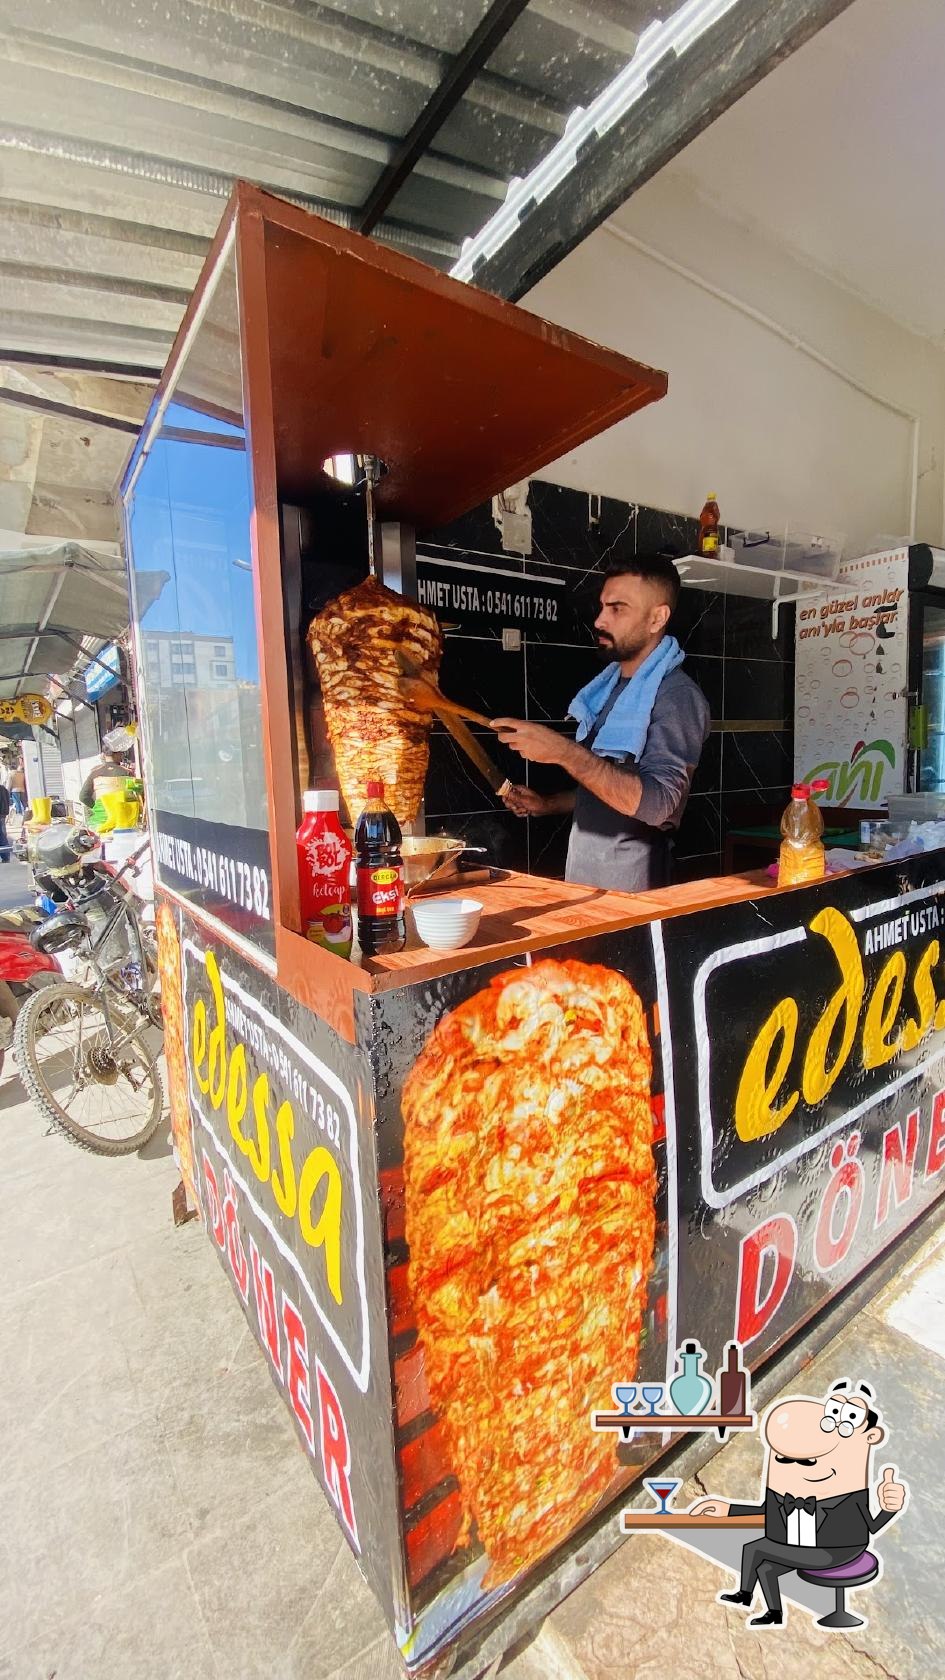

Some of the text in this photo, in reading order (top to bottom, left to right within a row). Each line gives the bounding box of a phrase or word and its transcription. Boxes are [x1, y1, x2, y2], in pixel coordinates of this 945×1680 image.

[417, 579, 450, 608] HMET
[452, 584, 480, 612] USTA
[799, 607, 817, 621] en
[820, 595, 859, 619] güzel
[865, 914, 911, 956] AHMET
[910, 905, 940, 937] USTA
[193, 950, 342, 1305] edessa
[202, 1147, 361, 1553] DÖNER
